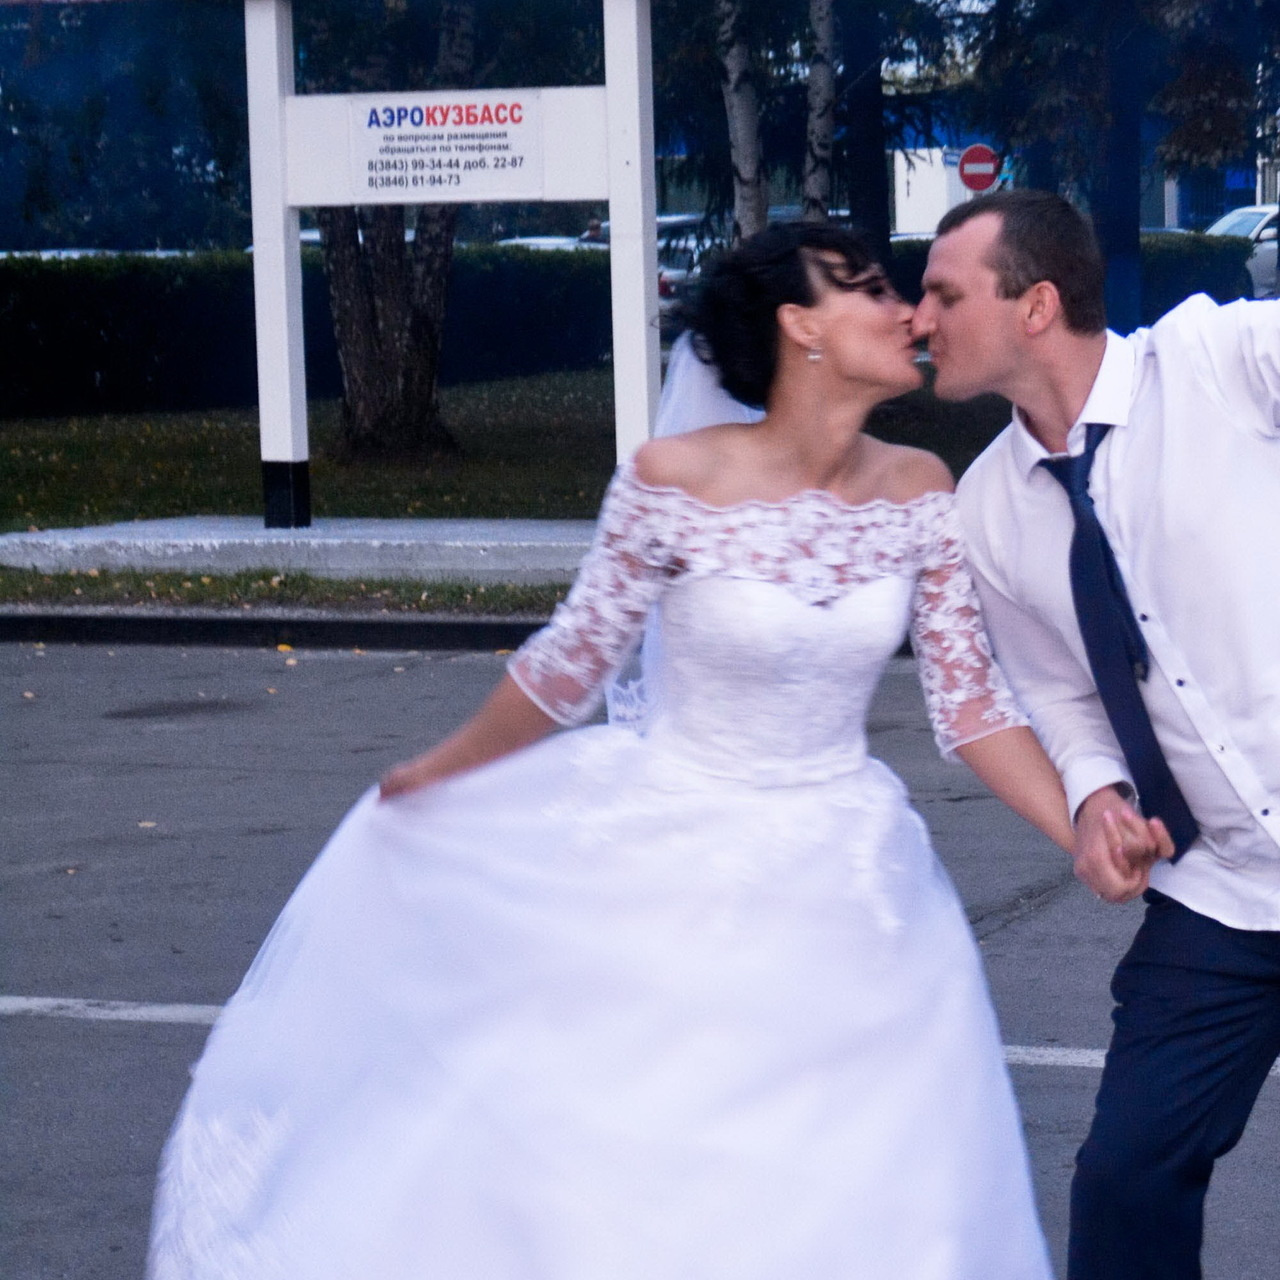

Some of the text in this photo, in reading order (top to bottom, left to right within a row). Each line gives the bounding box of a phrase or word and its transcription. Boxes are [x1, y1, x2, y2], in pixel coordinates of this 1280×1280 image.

[367, 102, 523, 128] АЭРОКУЗБАСС
[397, 133, 444, 143] вопросам
[447, 131, 508, 143] размещения
[379, 144, 437, 155] обращаться
[367, 156, 524, 172] 8(3843) 99-34-44 доб. 22-87
[411, 173, 461, 187] 61-94-73
